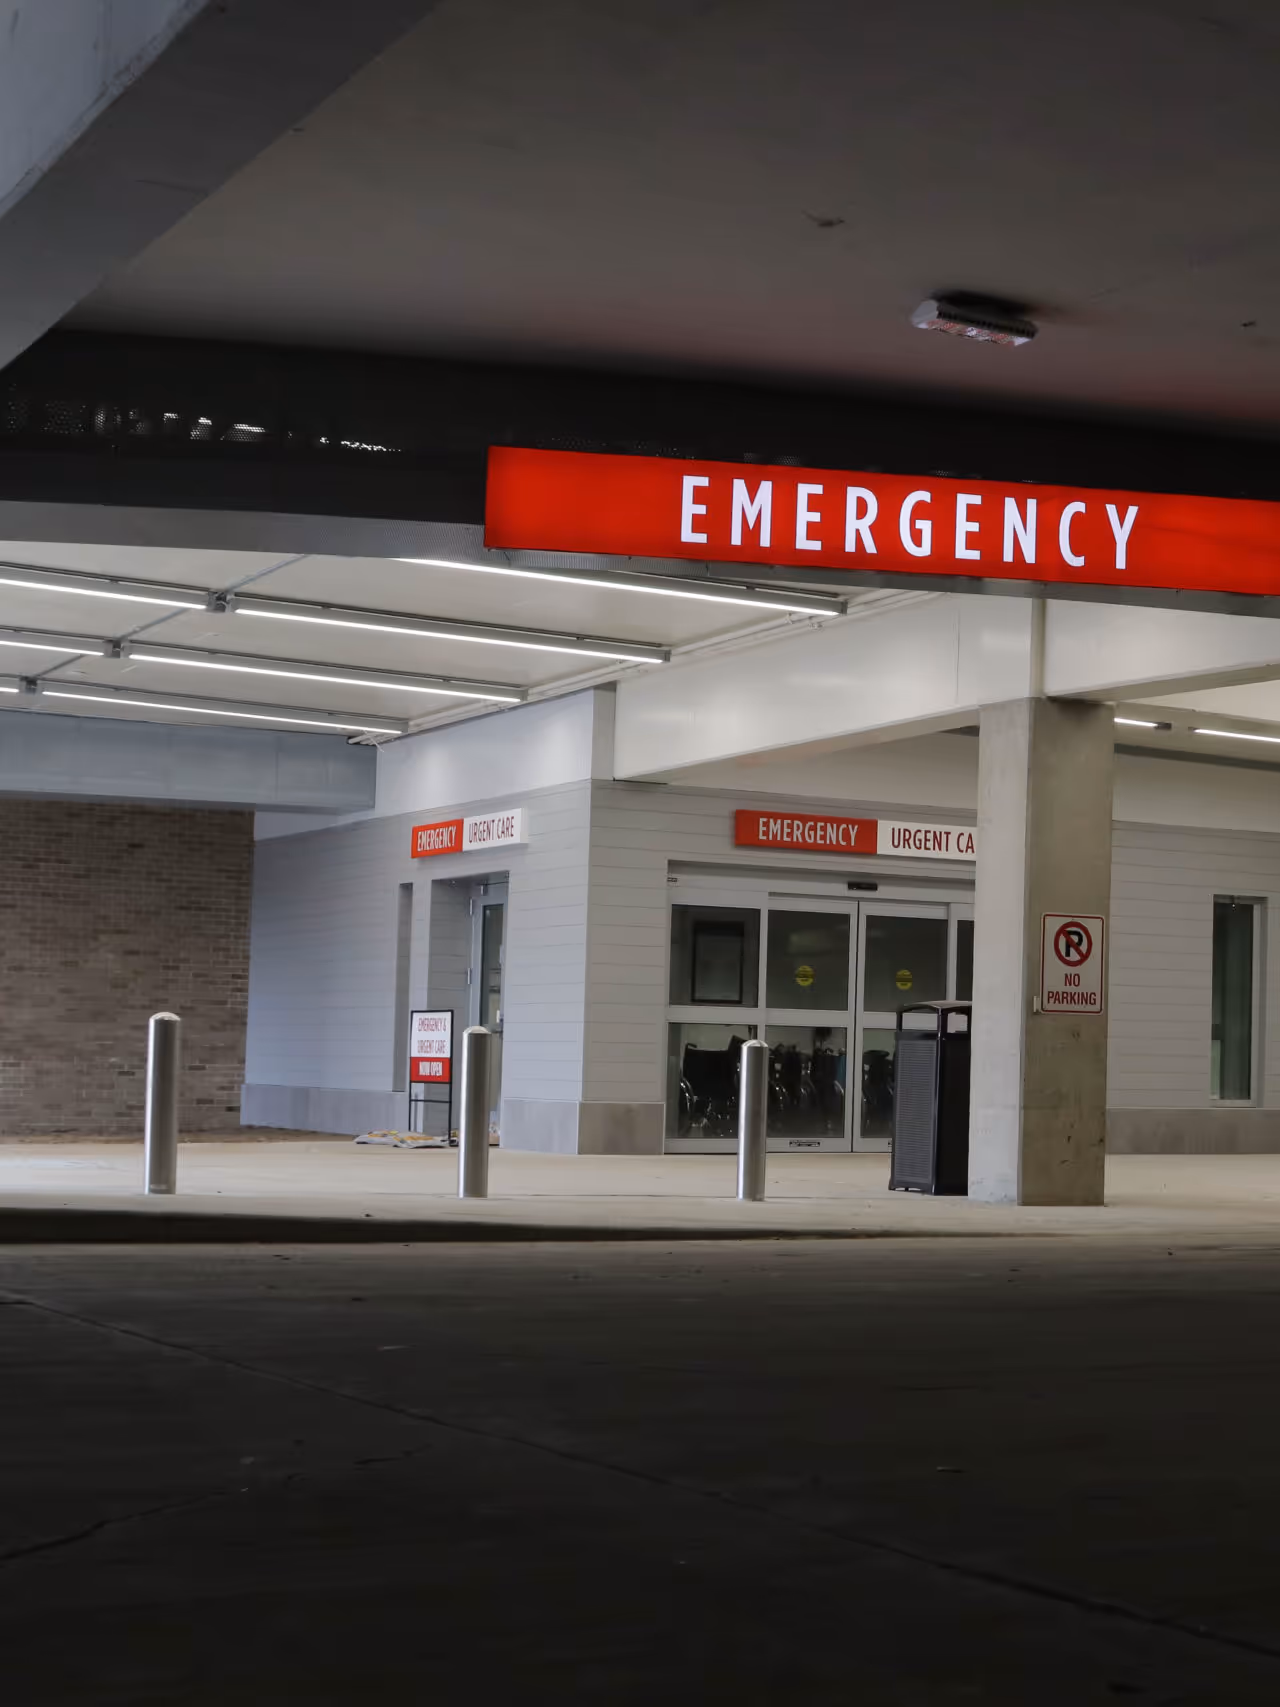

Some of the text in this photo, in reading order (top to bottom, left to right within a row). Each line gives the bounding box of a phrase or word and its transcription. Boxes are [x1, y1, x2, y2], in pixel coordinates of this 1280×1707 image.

[680, 475, 1139, 570] EMERGENCY
[417, 825, 457, 852] EMERGENCY
[468, 816, 515, 844] URGENT CARE
[758, 817, 859, 846] EMERGENCY
[891, 827, 951, 852] URGENT
[1064, 973, 1081, 987] NO
[1047, 990, 1097, 1006] PARKING
[417, 1017, 442, 1032] EMERGENCY
[434, 1039, 446, 1054] CARE
[431, 1061, 443, 1076] OPEN
